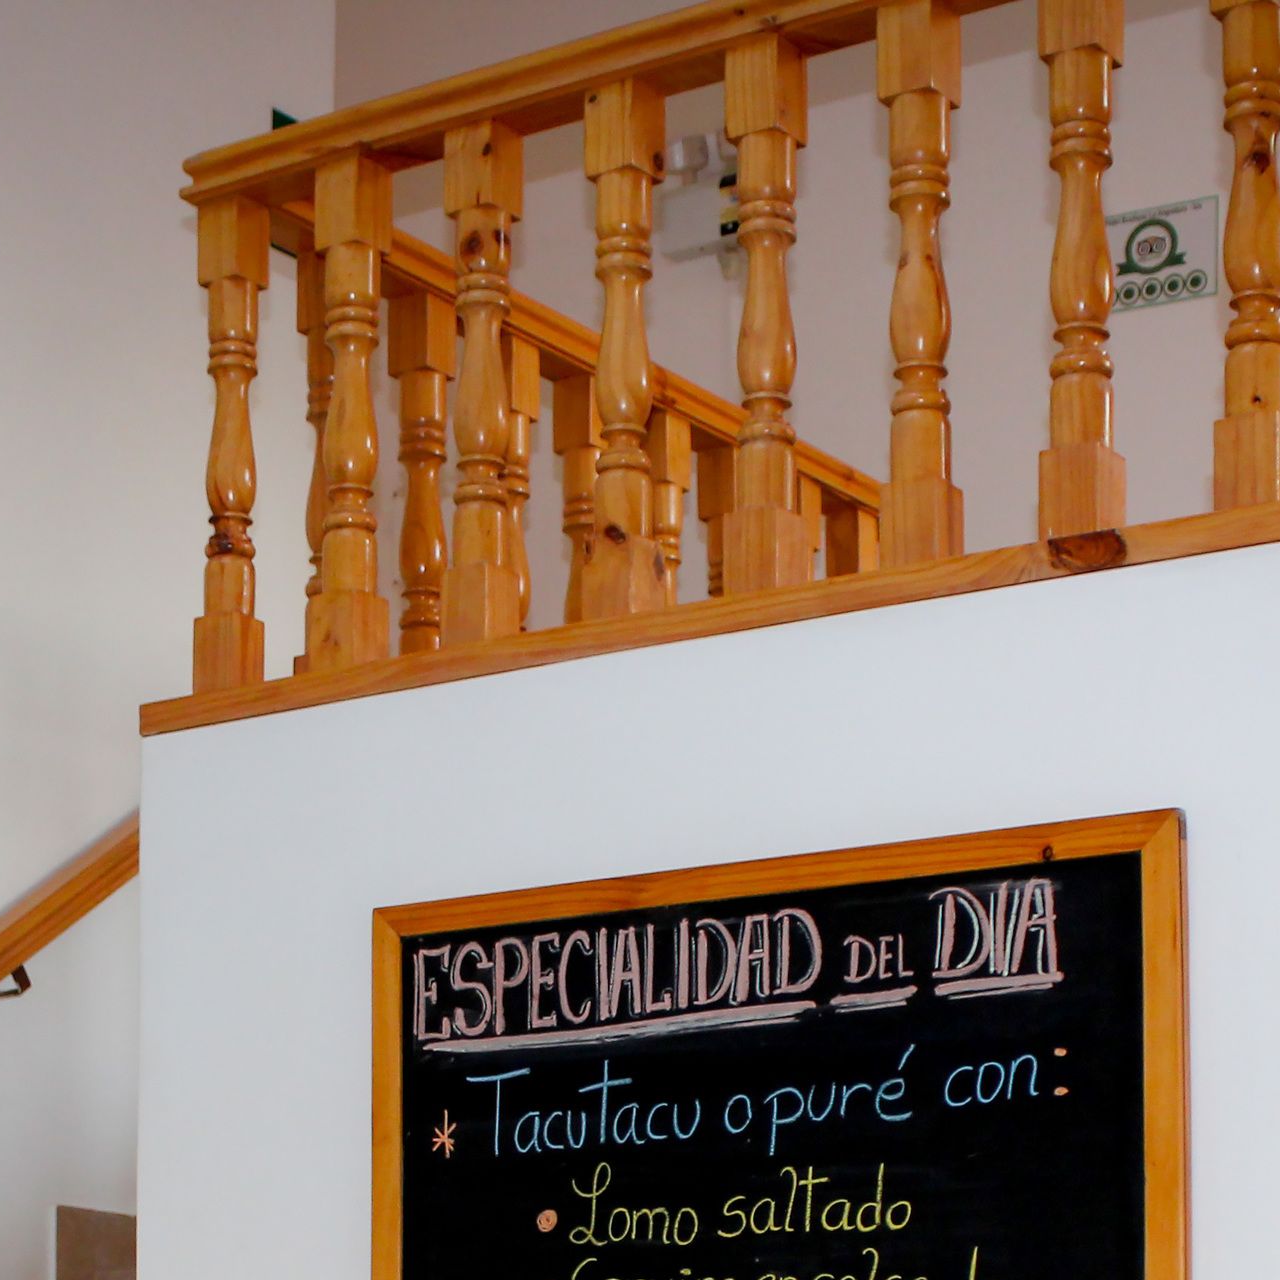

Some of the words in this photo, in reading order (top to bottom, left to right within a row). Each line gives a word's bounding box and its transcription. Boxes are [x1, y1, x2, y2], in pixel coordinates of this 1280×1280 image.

[413, 908, 822, 1040] ESPECIALIDAD
[843, 934, 914, 983] DEL
[725, 1102, 752, 1133] o
[765, 1044, 914, 1155] puré
[570, 1163, 698, 1245] Lomo
[718, 1163, 911, 1237] saltado
